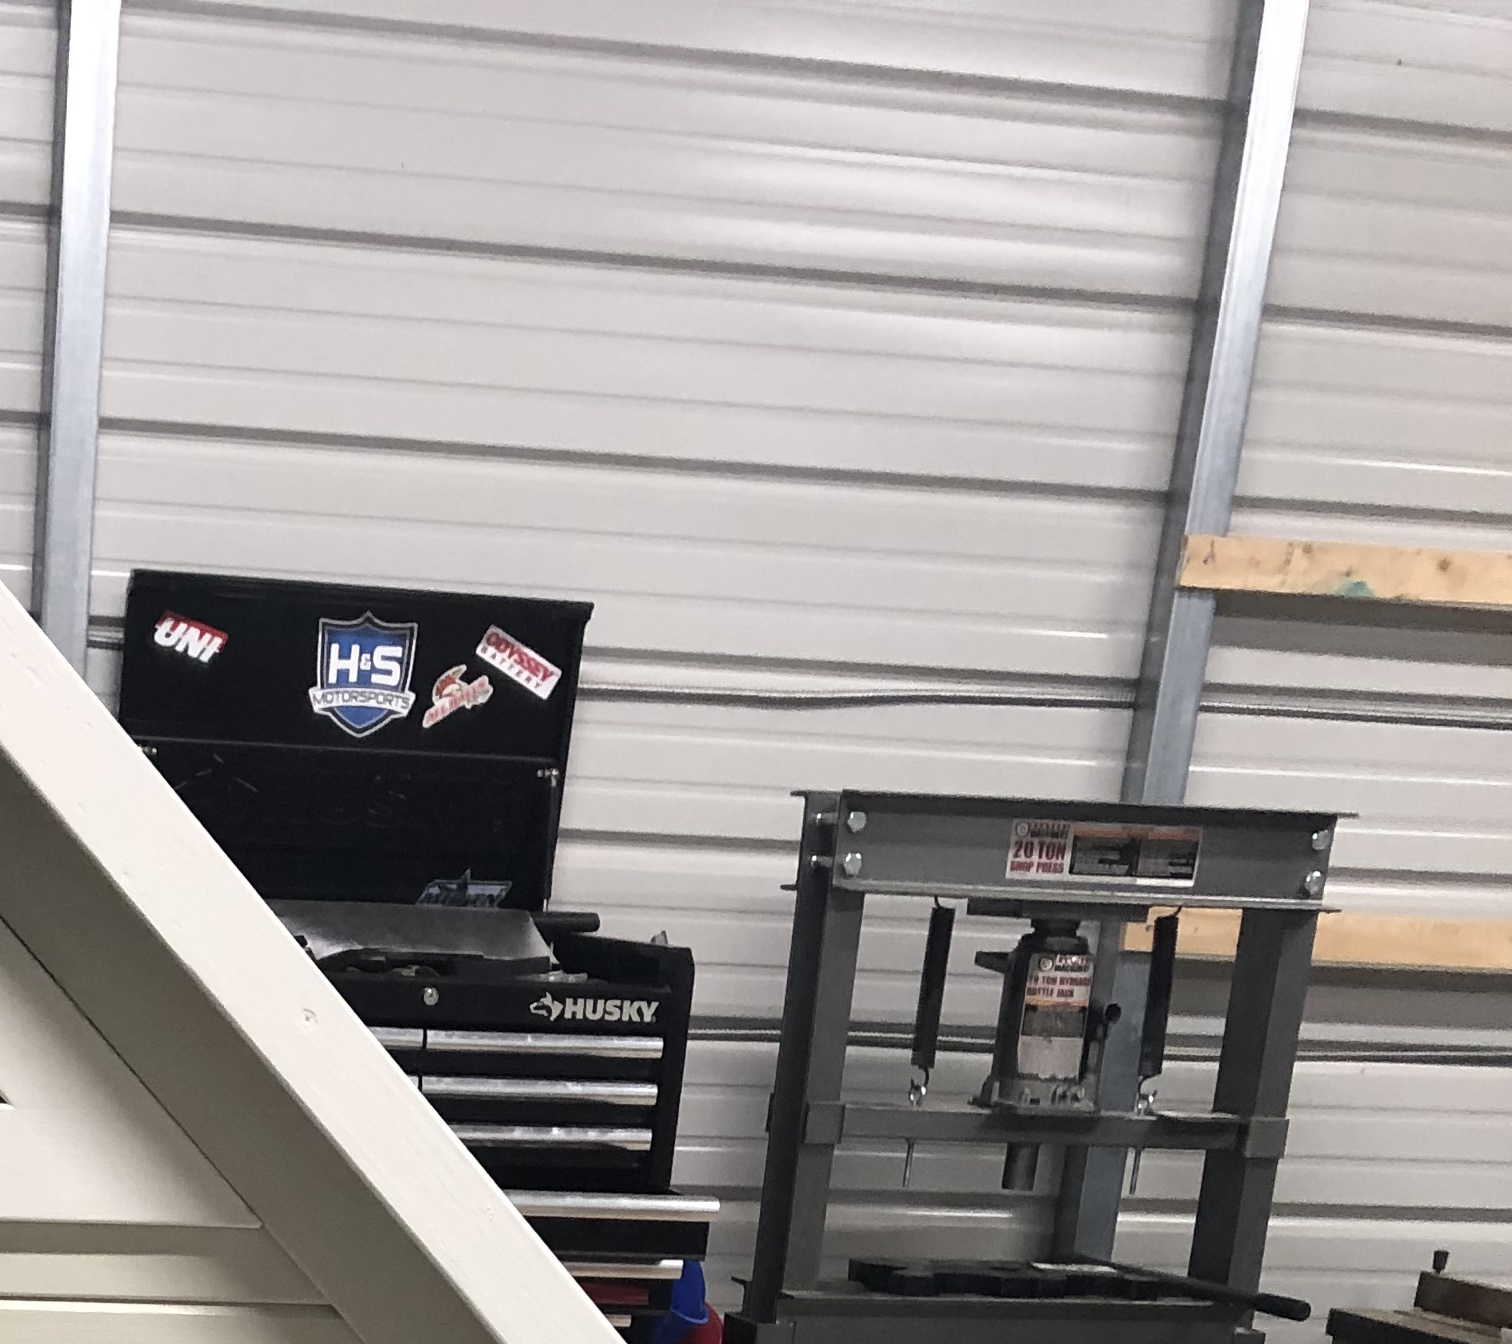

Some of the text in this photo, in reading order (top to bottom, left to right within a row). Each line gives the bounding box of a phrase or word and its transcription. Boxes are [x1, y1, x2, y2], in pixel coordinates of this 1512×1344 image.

[154, 617, 223, 663] UNI
[486, 632, 555, 682] ODYSSEY
[329, 643, 402, 687] H&S
[481, 645, 541, 688] BATTERY
[313, 690, 411, 709] MOTORSPORTS
[1013, 840, 1067, 860] 20 TON
[564, 998, 659, 1022] HUSKY
